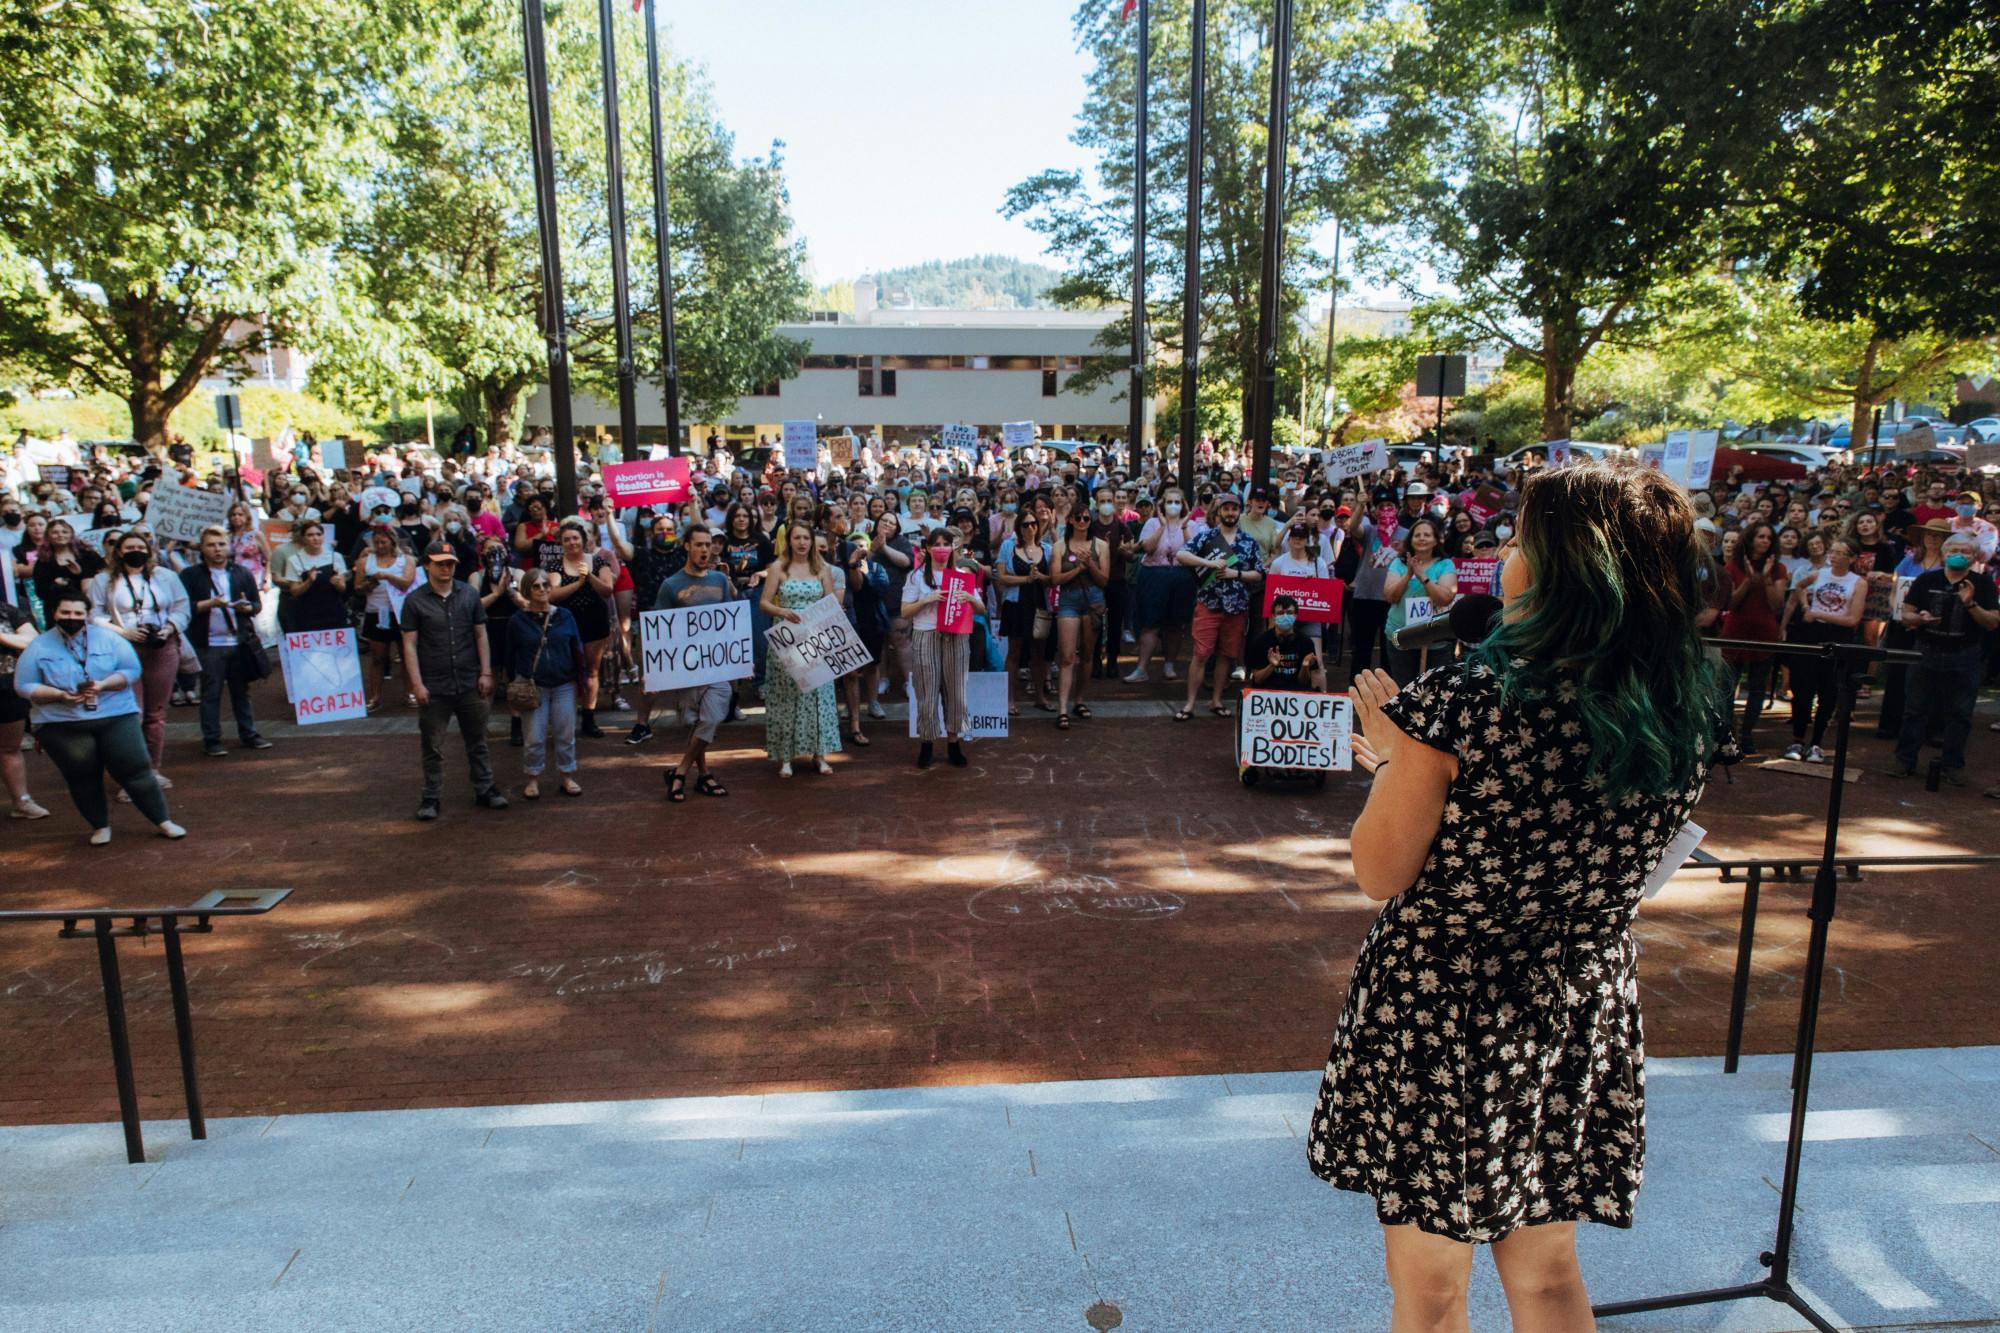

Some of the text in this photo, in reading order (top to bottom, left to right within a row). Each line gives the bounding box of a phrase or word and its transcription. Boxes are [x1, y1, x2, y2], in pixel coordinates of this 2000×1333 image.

[945, 432, 976, 440] FORCED
[947, 439, 972, 447] BIRTH
[616, 472, 655, 482] Abortion
[1346, 463, 1370, 474] COURT
[616, 480, 680, 491] Health Care.
[155, 518, 201, 537] AS GU
[1274, 587, 1318, 598] Abortion is
[1306, 599, 1331, 608] Care.
[1410, 601, 1432, 618] ABO
[645, 606, 740, 641] MY BODY
[289, 631, 345, 650] NEVER
[770, 626, 795, 650] NO
[797, 625, 846, 664] FORCED
[645, 638, 750, 673] MY CHOICE
[824, 644, 869, 675] BIRTH
[300, 689, 364, 716] AGAIN
[1251, 695, 1344, 719] BANS OFF
[973, 716, 1007, 729] BIRTH
[1271, 719, 1319, 740] OUR
[1252, 736, 1337, 768] BODIES!
